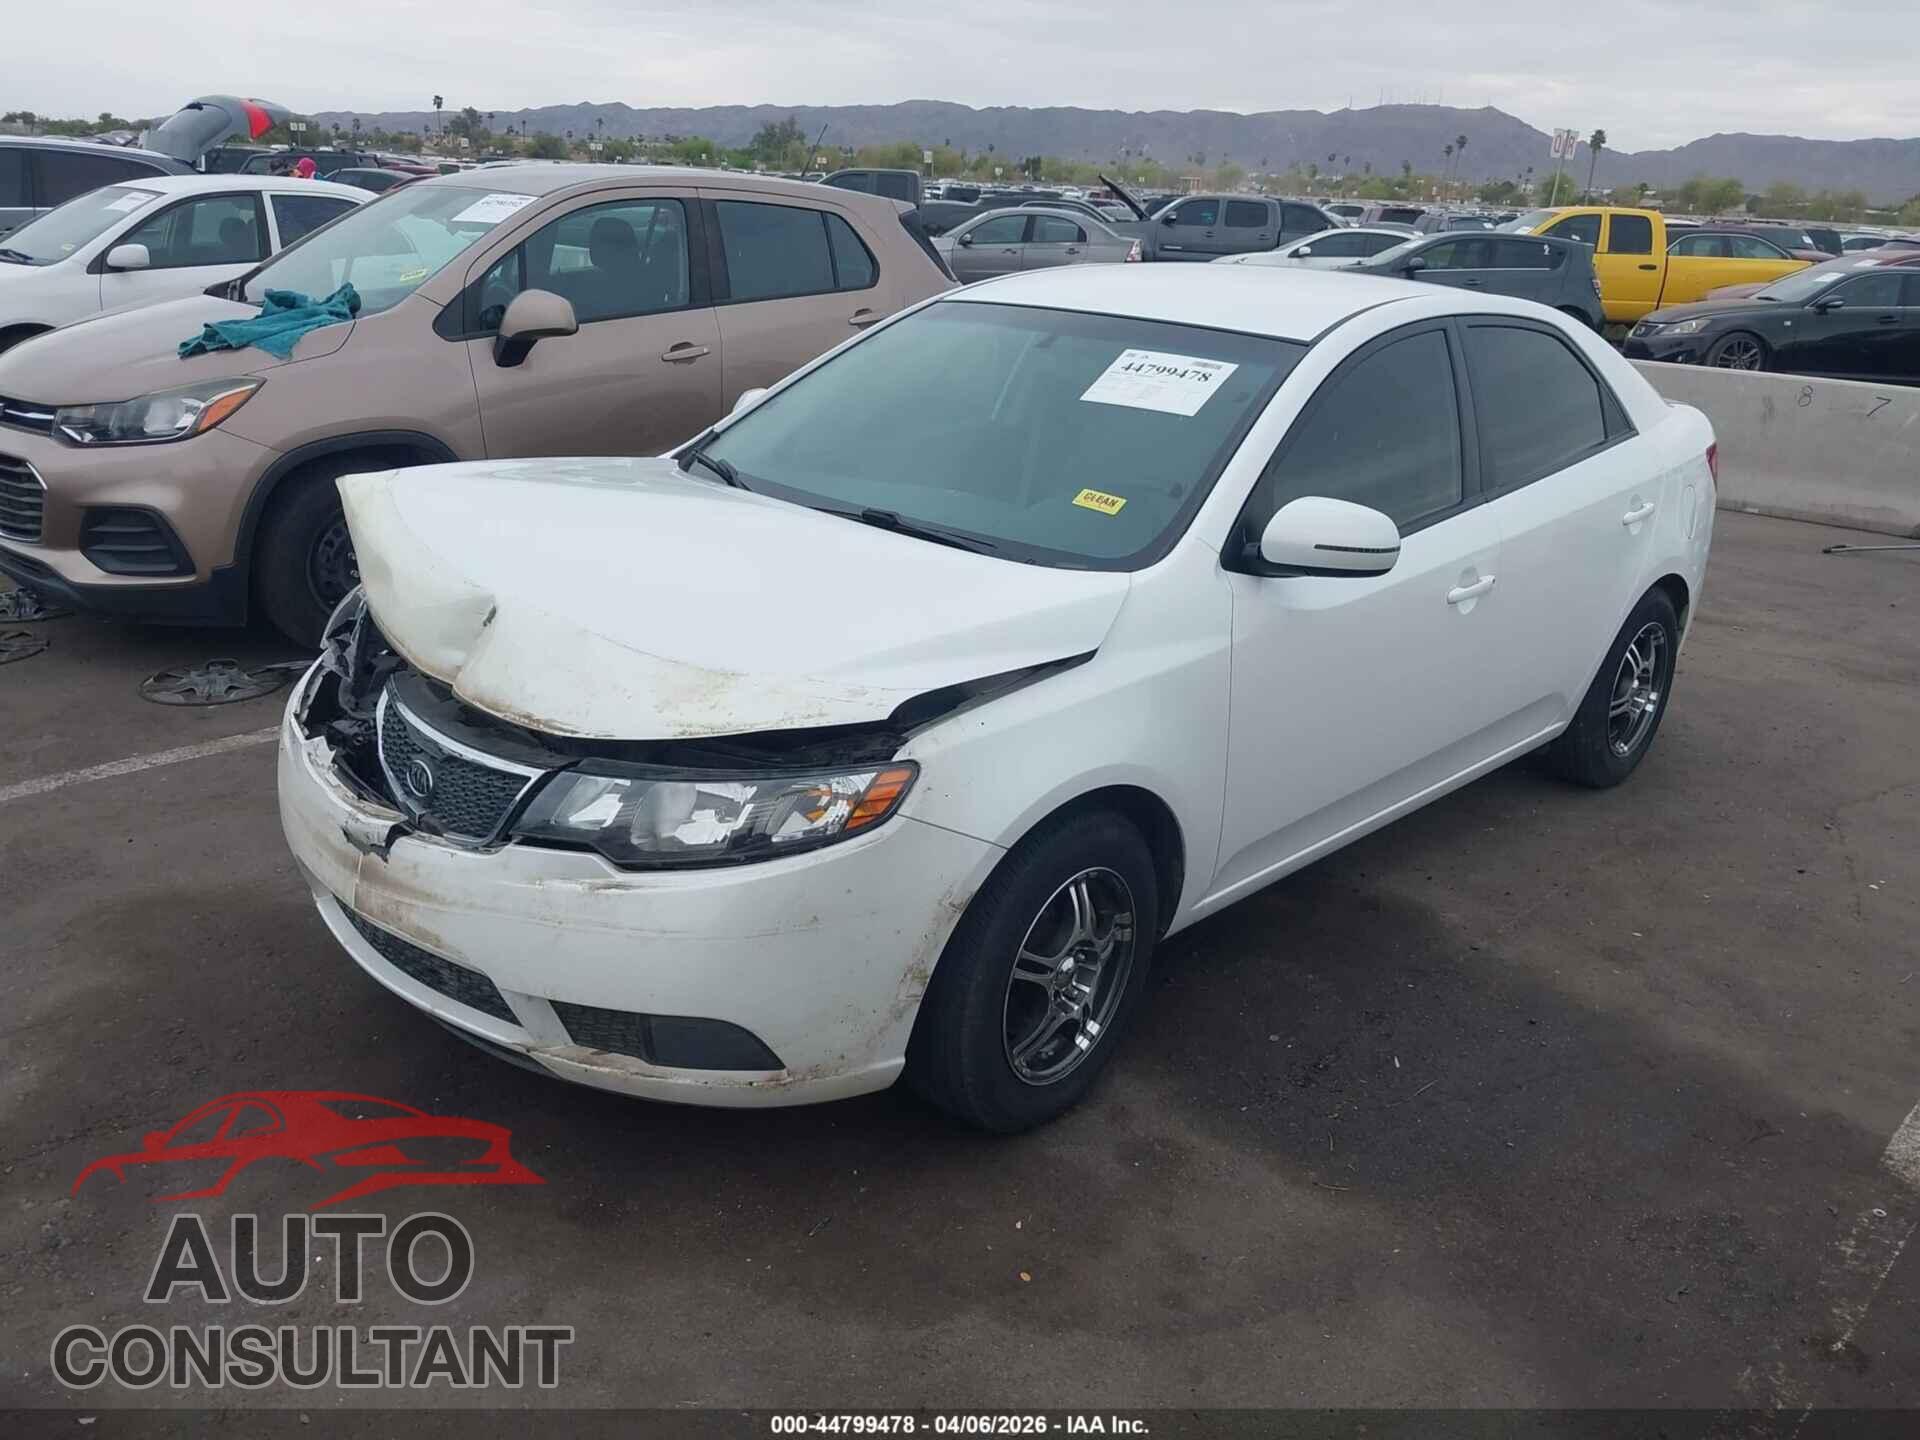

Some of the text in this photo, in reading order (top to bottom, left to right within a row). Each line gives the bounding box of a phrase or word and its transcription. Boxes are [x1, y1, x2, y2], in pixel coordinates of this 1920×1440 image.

[1121, 361, 1213, 383] 44799478
[1797, 384, 1892, 417] 8 7
[1083, 492, 1119, 507] CLEAN
